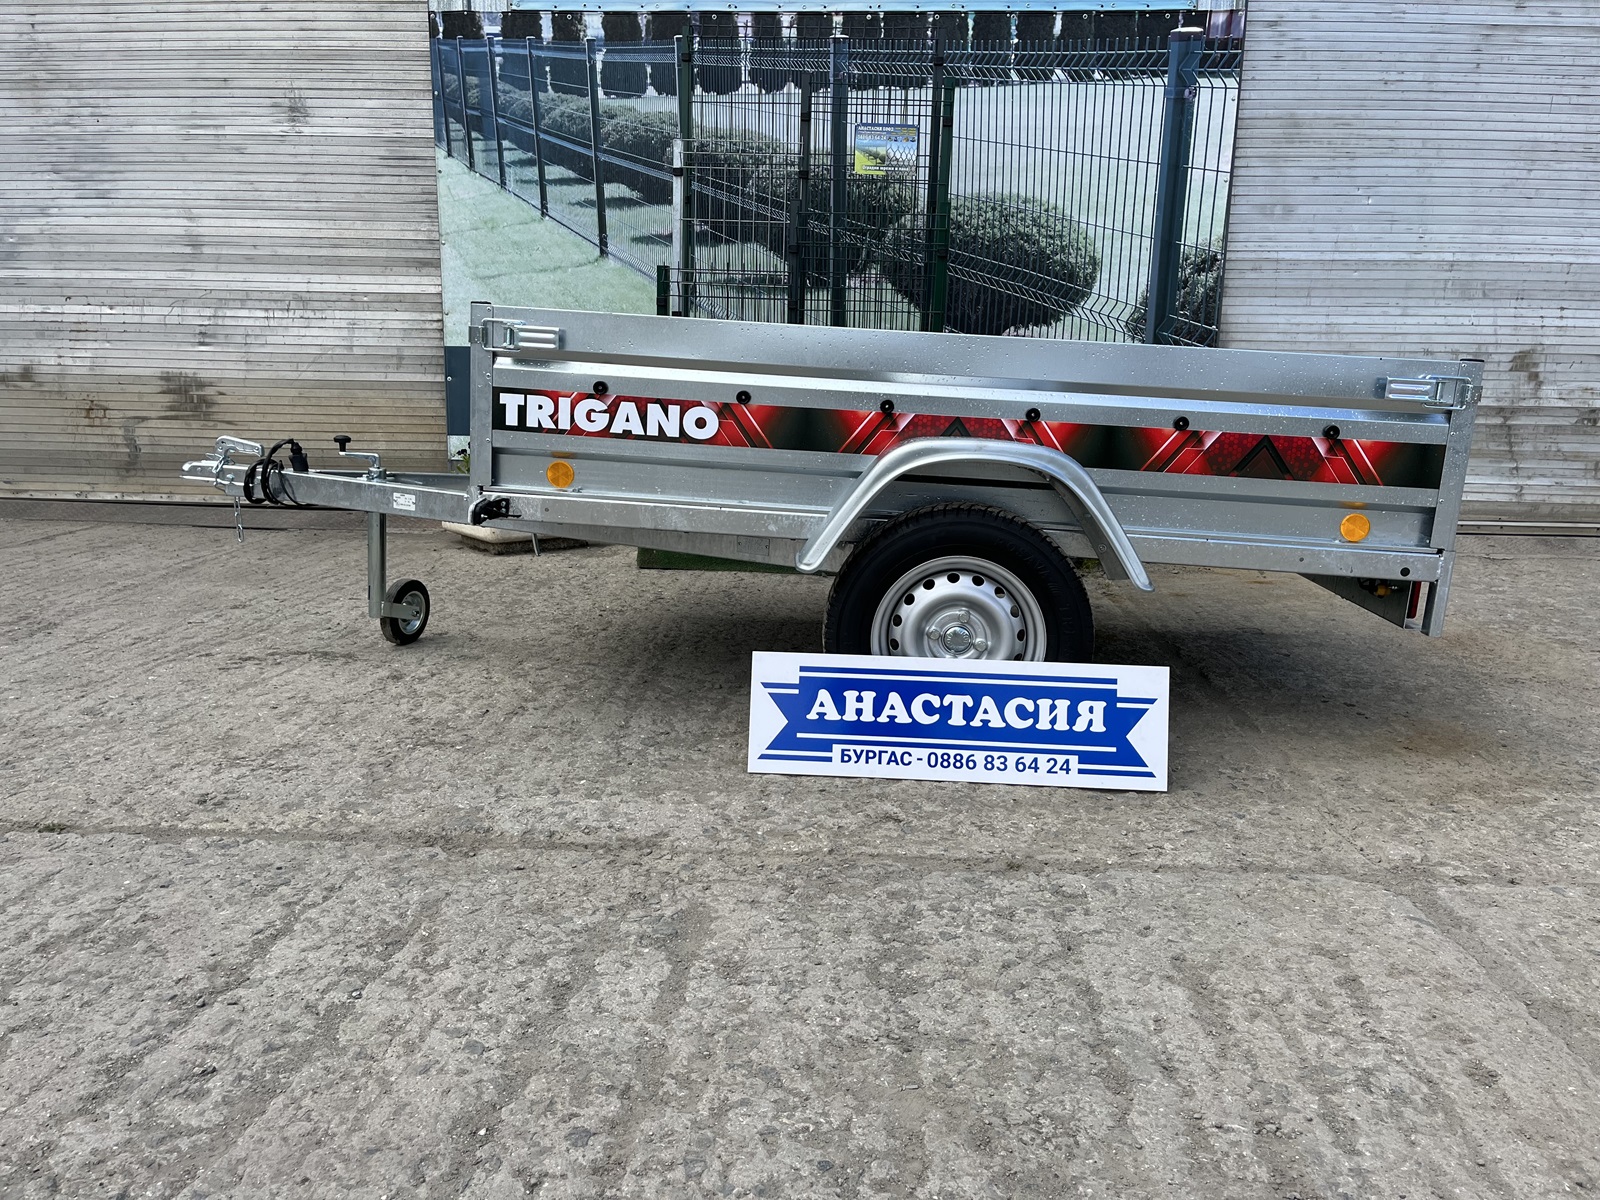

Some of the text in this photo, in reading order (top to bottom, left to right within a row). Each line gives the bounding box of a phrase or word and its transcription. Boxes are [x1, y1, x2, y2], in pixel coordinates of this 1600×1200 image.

[499, 393, 719, 440] TRIGANO
[806, 689, 1106, 732] АНАСТАСИЯ
[840, 749, 912, 766] БУРГАС
[927, 752, 977, 770] 0886
[984, 754, 1008, 772] 83
[1015, 756, 1040, 773] 64
[1046, 758, 1071, 775] 24
